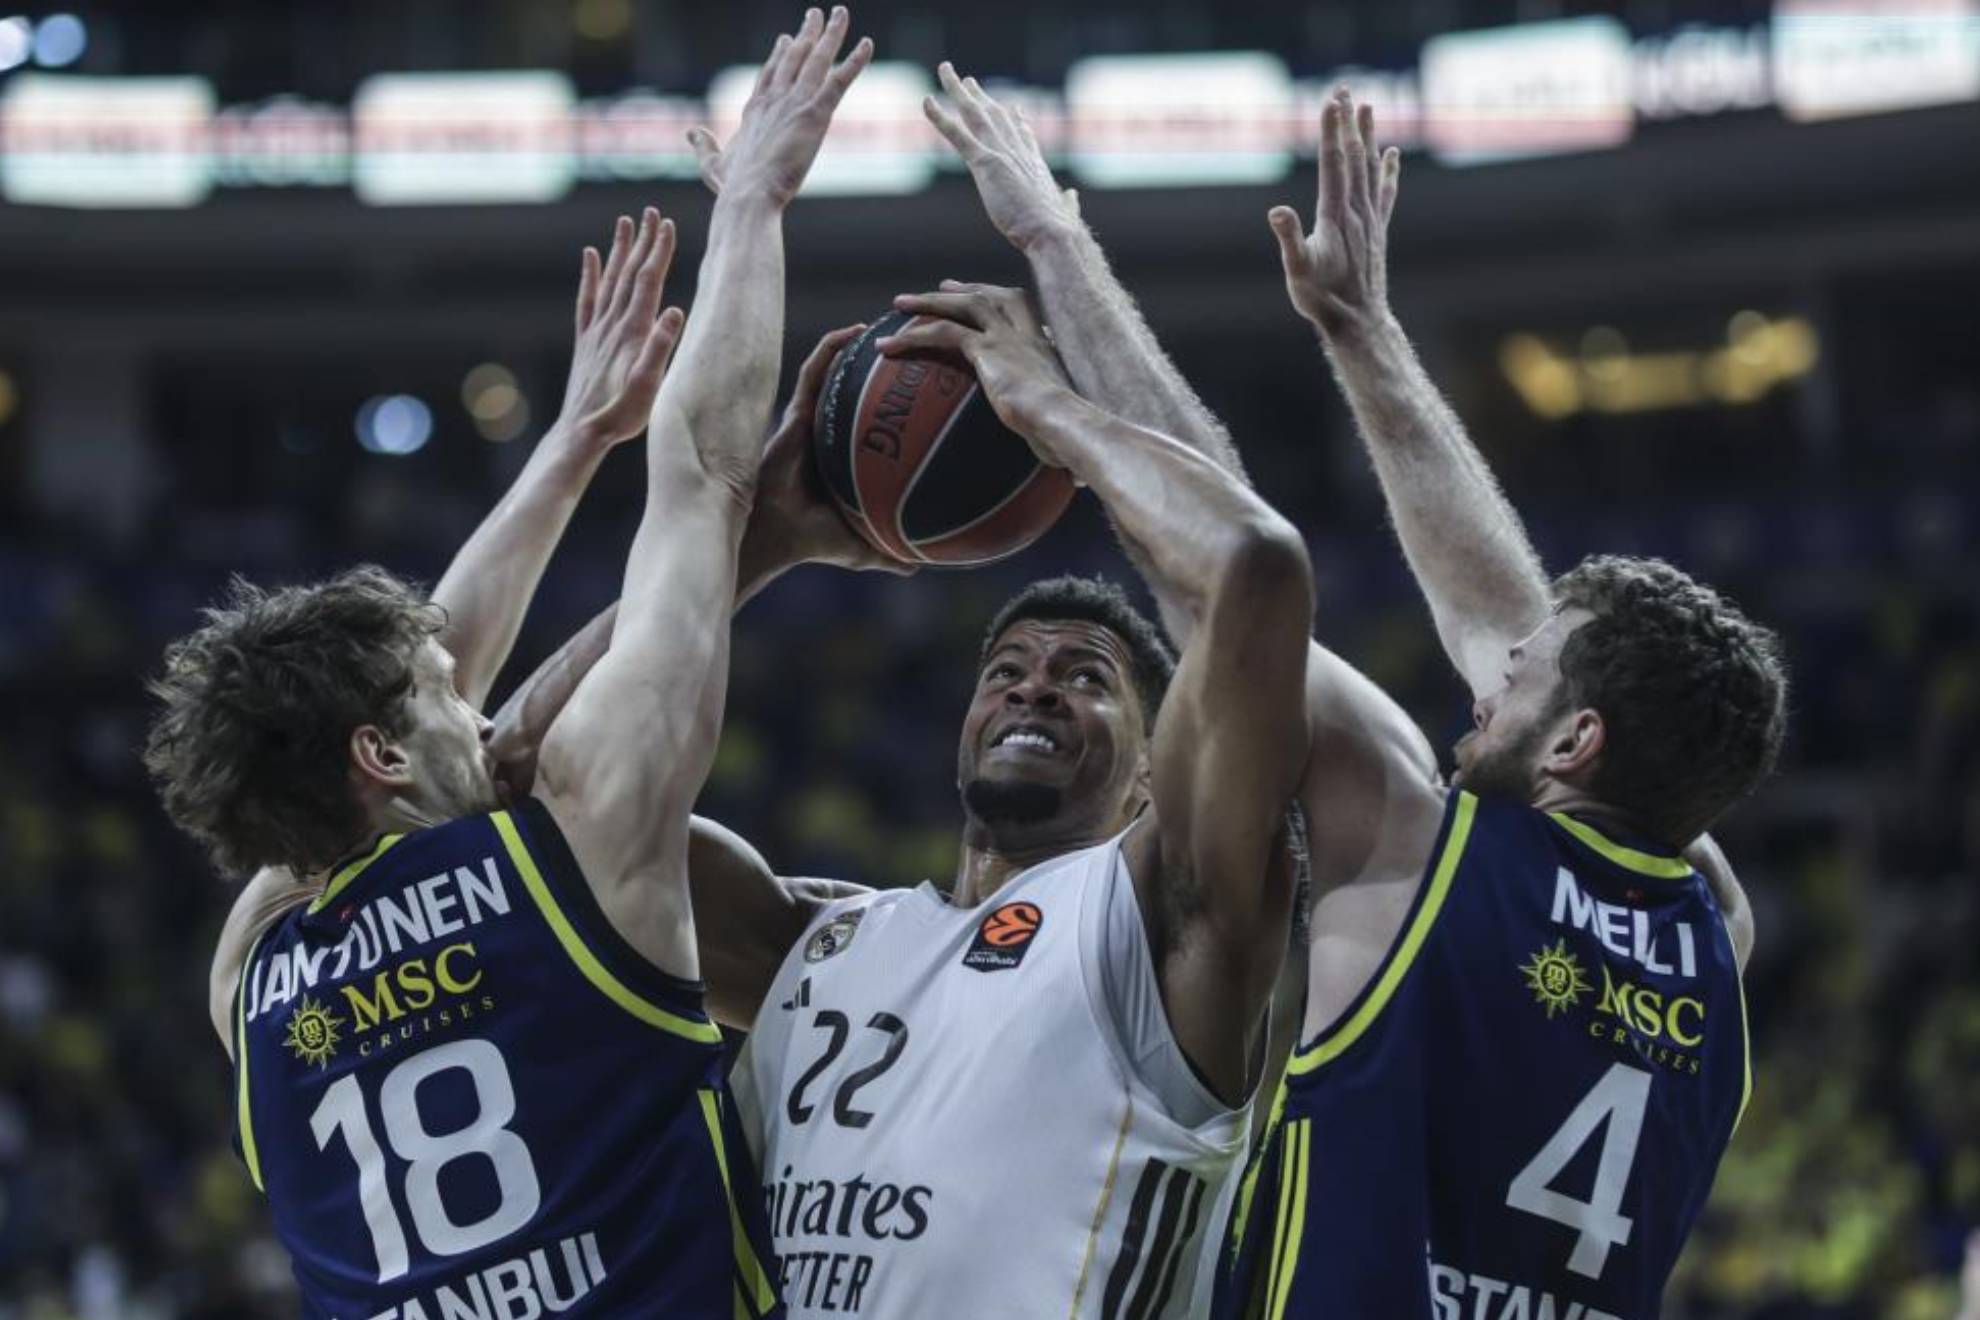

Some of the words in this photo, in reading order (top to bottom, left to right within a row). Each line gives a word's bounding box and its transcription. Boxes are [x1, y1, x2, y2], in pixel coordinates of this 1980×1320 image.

[340, 943, 482, 1034] MSC
[360, 996, 495, 1057] CRUISES
[1596, 961, 1703, 1047] MSC
[787, 1010, 908, 1128] 22
[309, 1038, 541, 1285] 18
[1506, 1062, 1652, 1280] 4
[775, 1251, 873, 1314] ETTER
